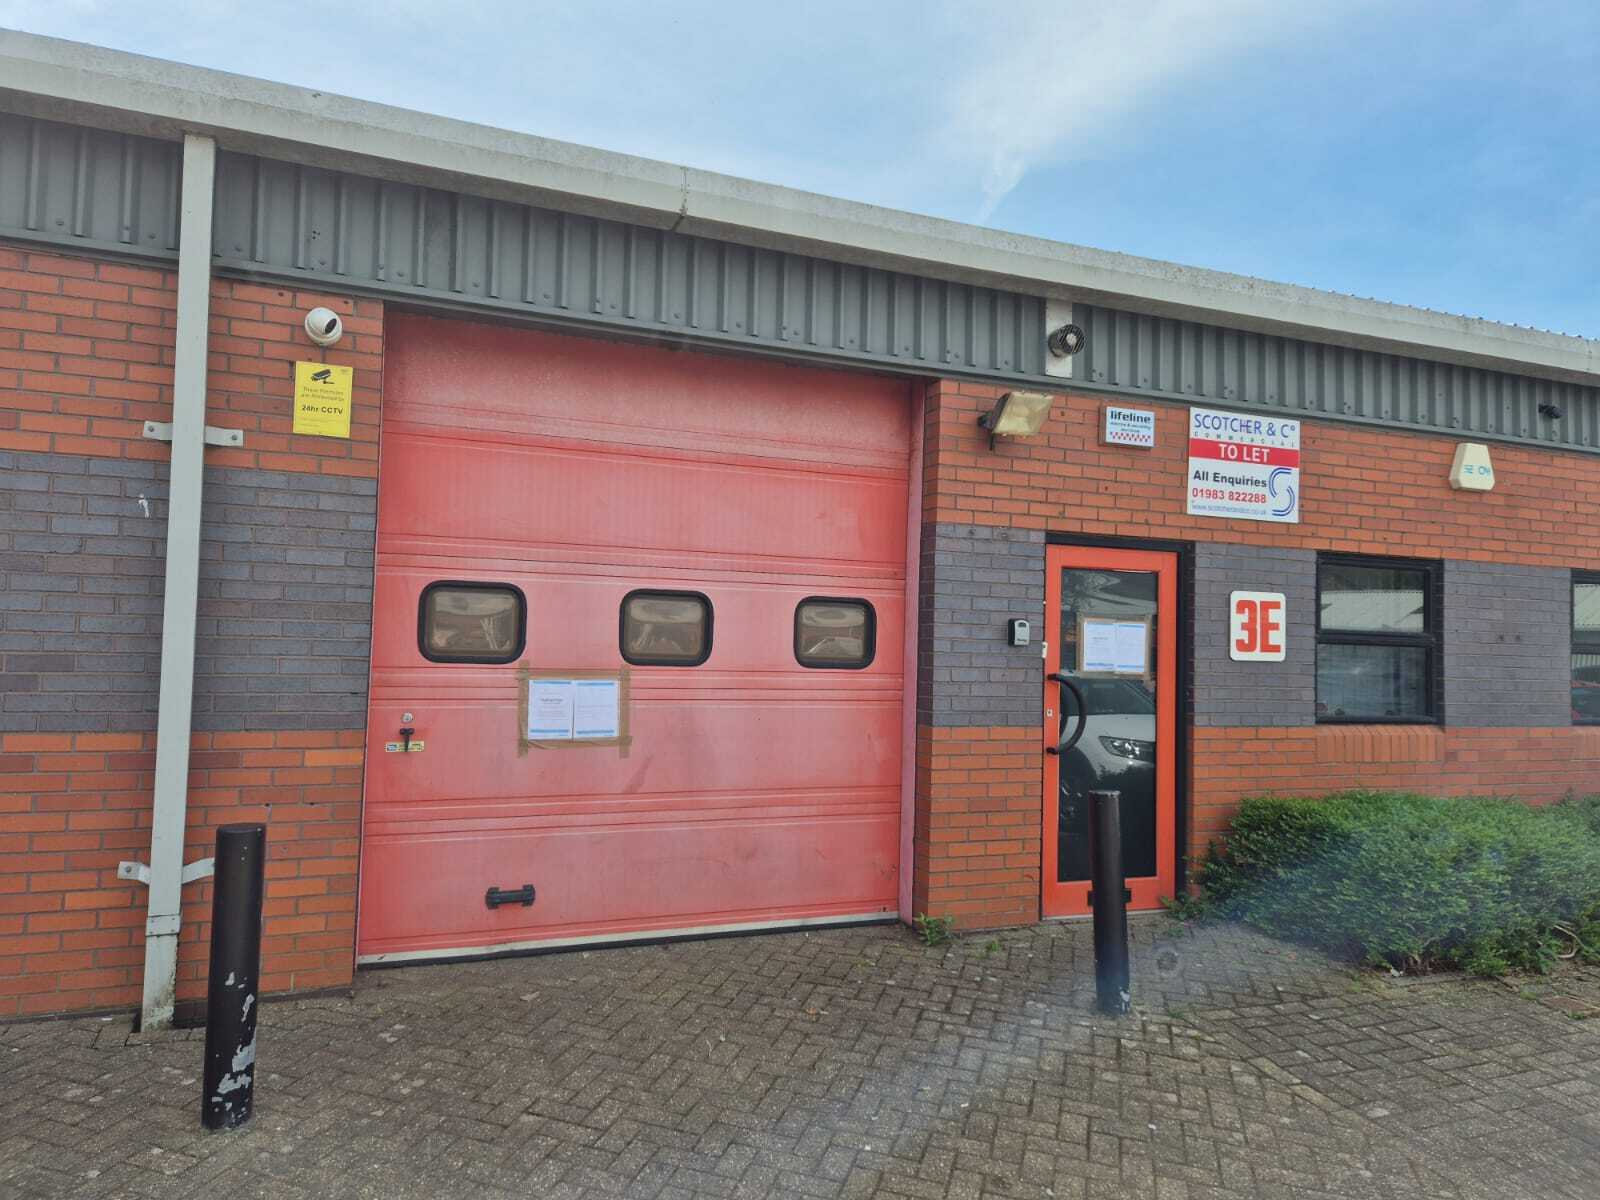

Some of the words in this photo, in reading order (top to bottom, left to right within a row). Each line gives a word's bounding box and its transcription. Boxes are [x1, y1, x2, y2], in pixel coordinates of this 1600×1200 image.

[302, 404, 318, 413] 24hr
[321, 406, 343, 415] CCTV
[1110, 410, 1151, 423] lifeline
[1194, 413, 1262, 435] SCOTCHER
[1266, 422, 1276, 437] &
[1219, 443, 1238, 460] TO
[1243, 446, 1270, 463] LET
[1193, 470, 1209, 481] All
[1213, 472, 1267, 488] Enquiries
[1192, 487, 1225, 500] 01983
[1228, 491, 1267, 504] 822288
[1235, 599, 1281, 653] 3E
